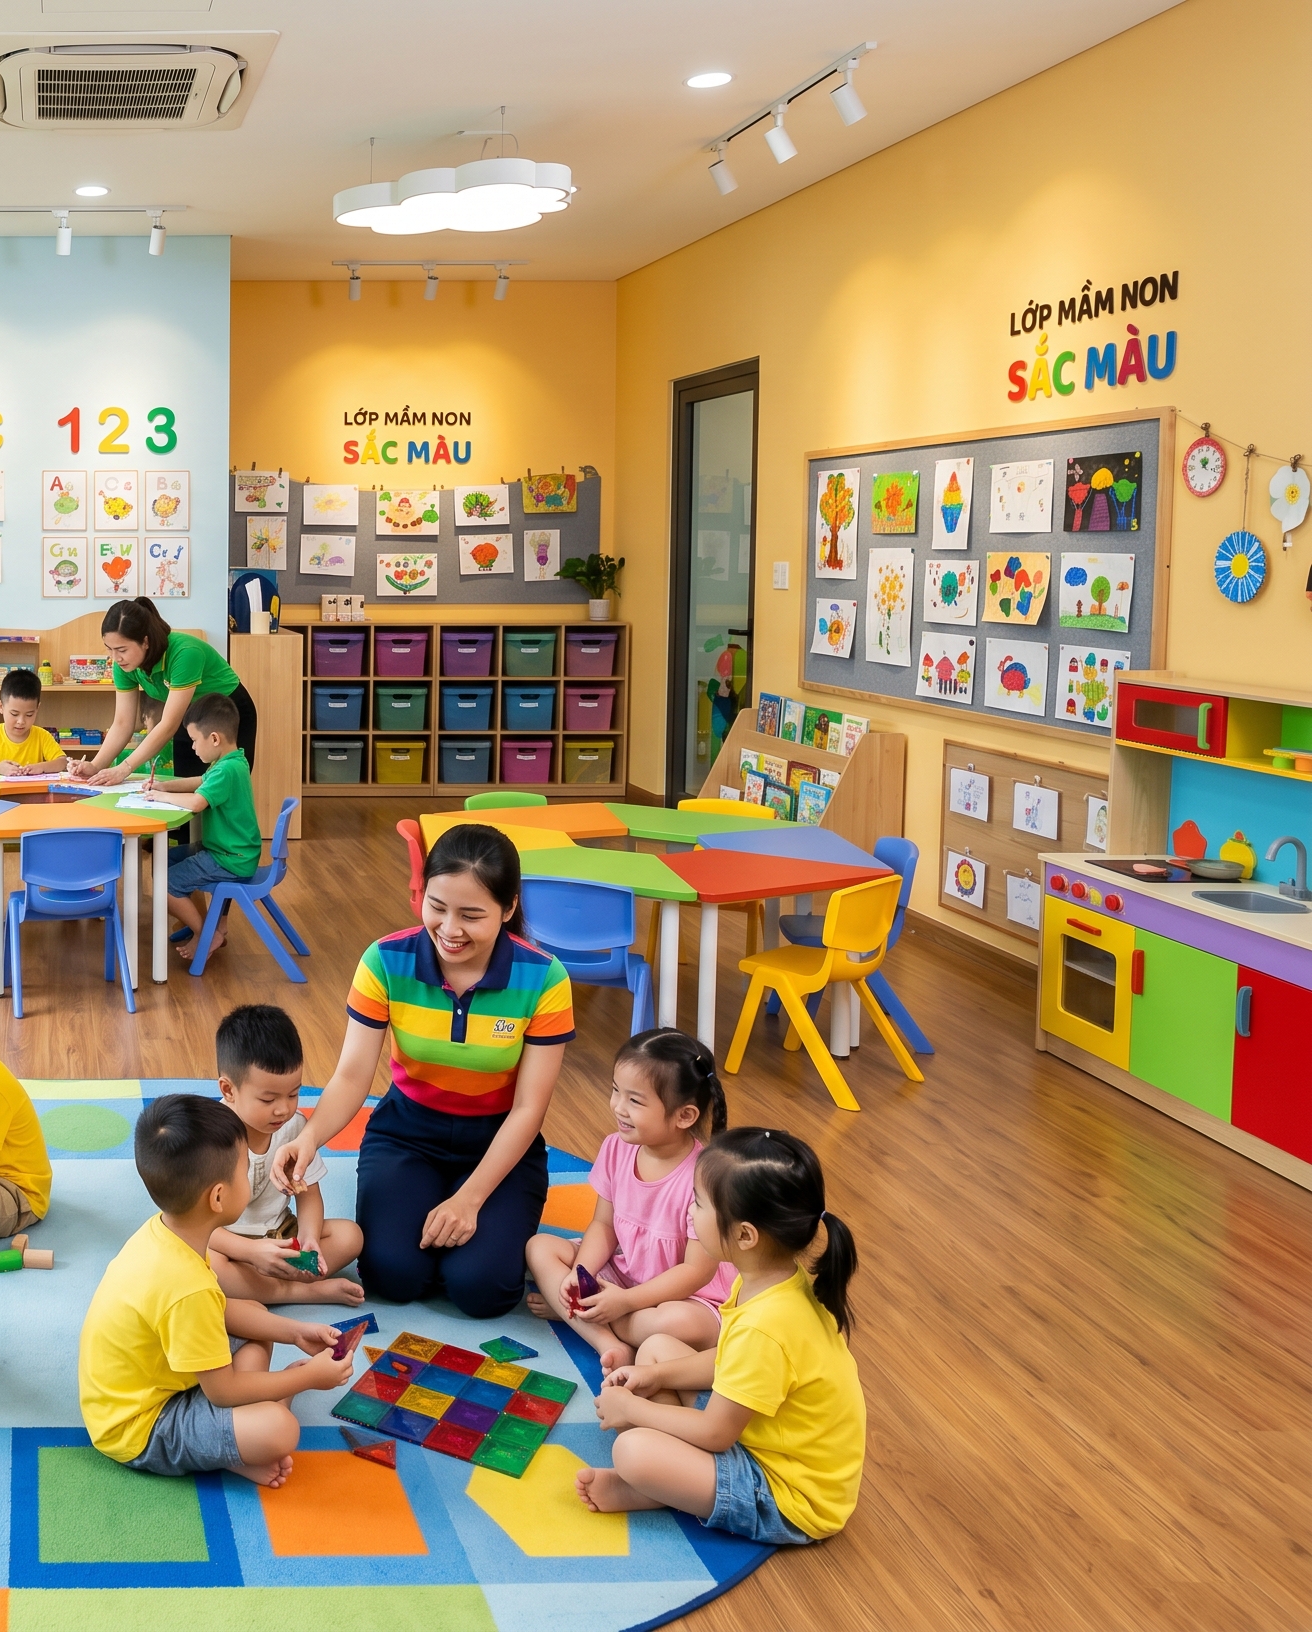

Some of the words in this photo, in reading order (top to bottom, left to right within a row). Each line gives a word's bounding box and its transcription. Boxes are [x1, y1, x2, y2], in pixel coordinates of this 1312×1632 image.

[1010, 299, 1052, 336] LỚP
[1058, 279, 1114, 326] MẦM
[1121, 270, 1179, 311] NON
[1008, 332, 1076, 403] SẮC
[1085, 323, 1178, 391] MÀU
[344, 407, 379, 426] LỚP
[384, 405, 427, 426] MẦM
[431, 411, 471, 426] NON
[343, 428, 398, 465] SẮC
[407, 434, 472, 465] MÀU
